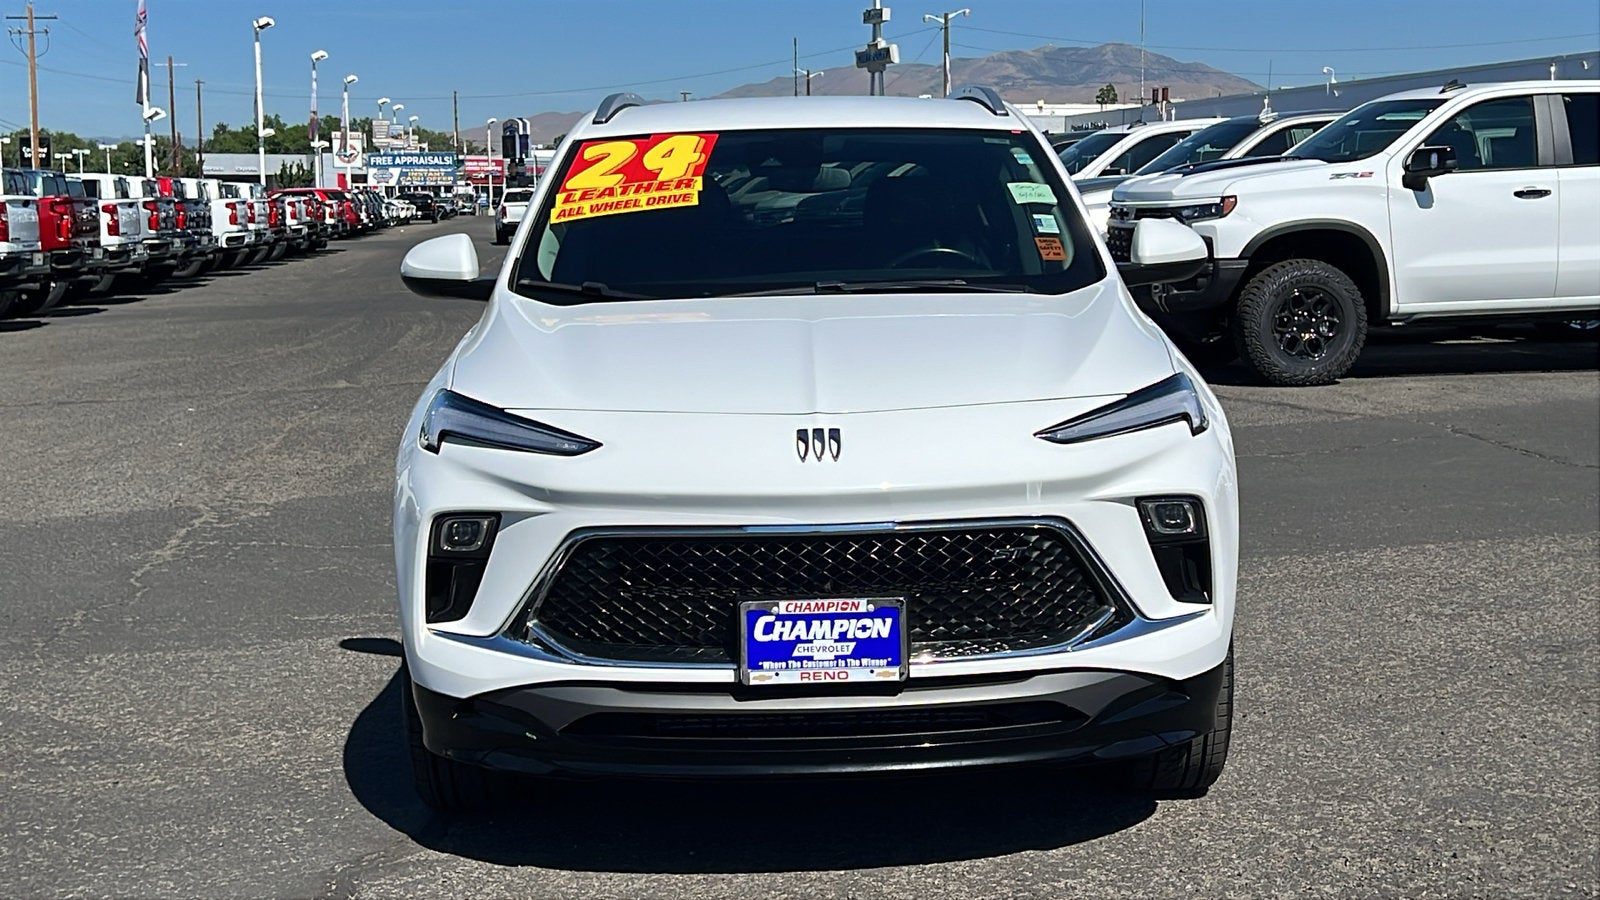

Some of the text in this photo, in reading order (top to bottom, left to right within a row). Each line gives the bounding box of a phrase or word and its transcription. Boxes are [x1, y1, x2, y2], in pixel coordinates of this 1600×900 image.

[370, 156, 393, 166] FREE
[566, 134, 707, 190] 24
[562, 178, 695, 204] LEATHER
[556, 193, 694, 219] ALL WHEEL DRIVE
[785, 601, 861, 613] CHAMPION
[753, 615, 893, 642] CHAMPION
[797, 645, 851, 654] CHEVROLET
[788, 660, 801, 669] The
[802, 660, 837, 669] Customer
[847, 658, 860, 668] The
[800, 671, 849, 681] RENO
